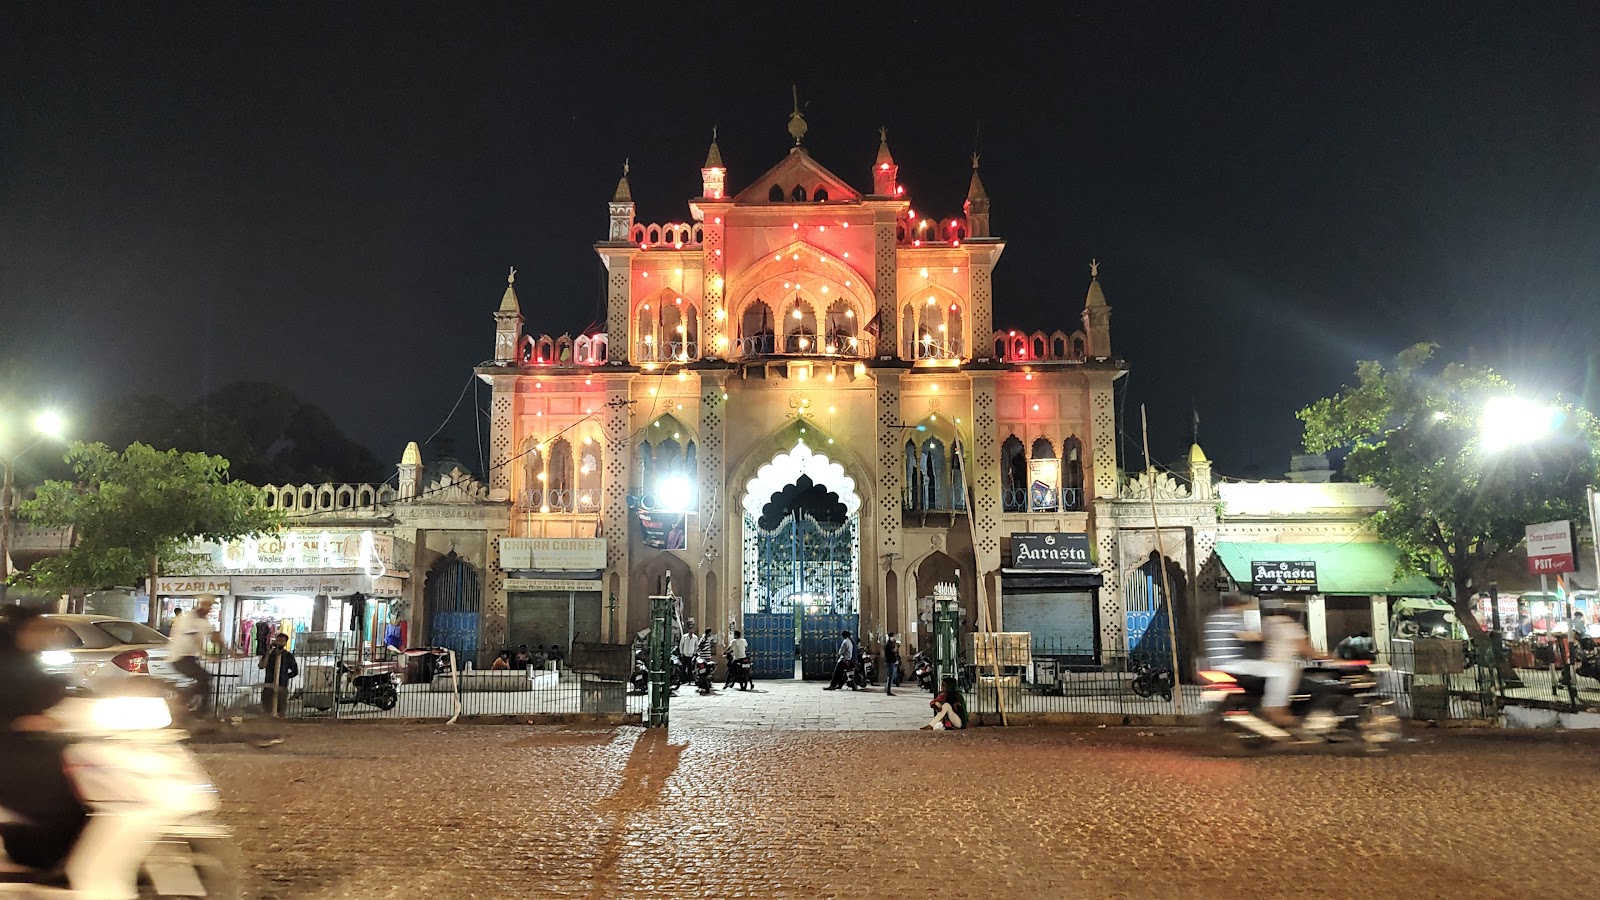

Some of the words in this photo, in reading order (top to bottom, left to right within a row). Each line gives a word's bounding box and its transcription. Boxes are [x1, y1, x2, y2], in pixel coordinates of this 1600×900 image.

[269, 541, 319, 554] CHIAN
[503, 540, 549, 551] CHIKAN
[553, 540, 603, 551] CORNER
[1016, 543, 1086, 562] Aarasta
[1534, 558, 1553, 570] PSIT
[1255, 566, 1315, 581] Aarasta
[161, 582, 172, 592] K
[174, 582, 205, 592] ZARI
[208, 581, 230, 592] Art
